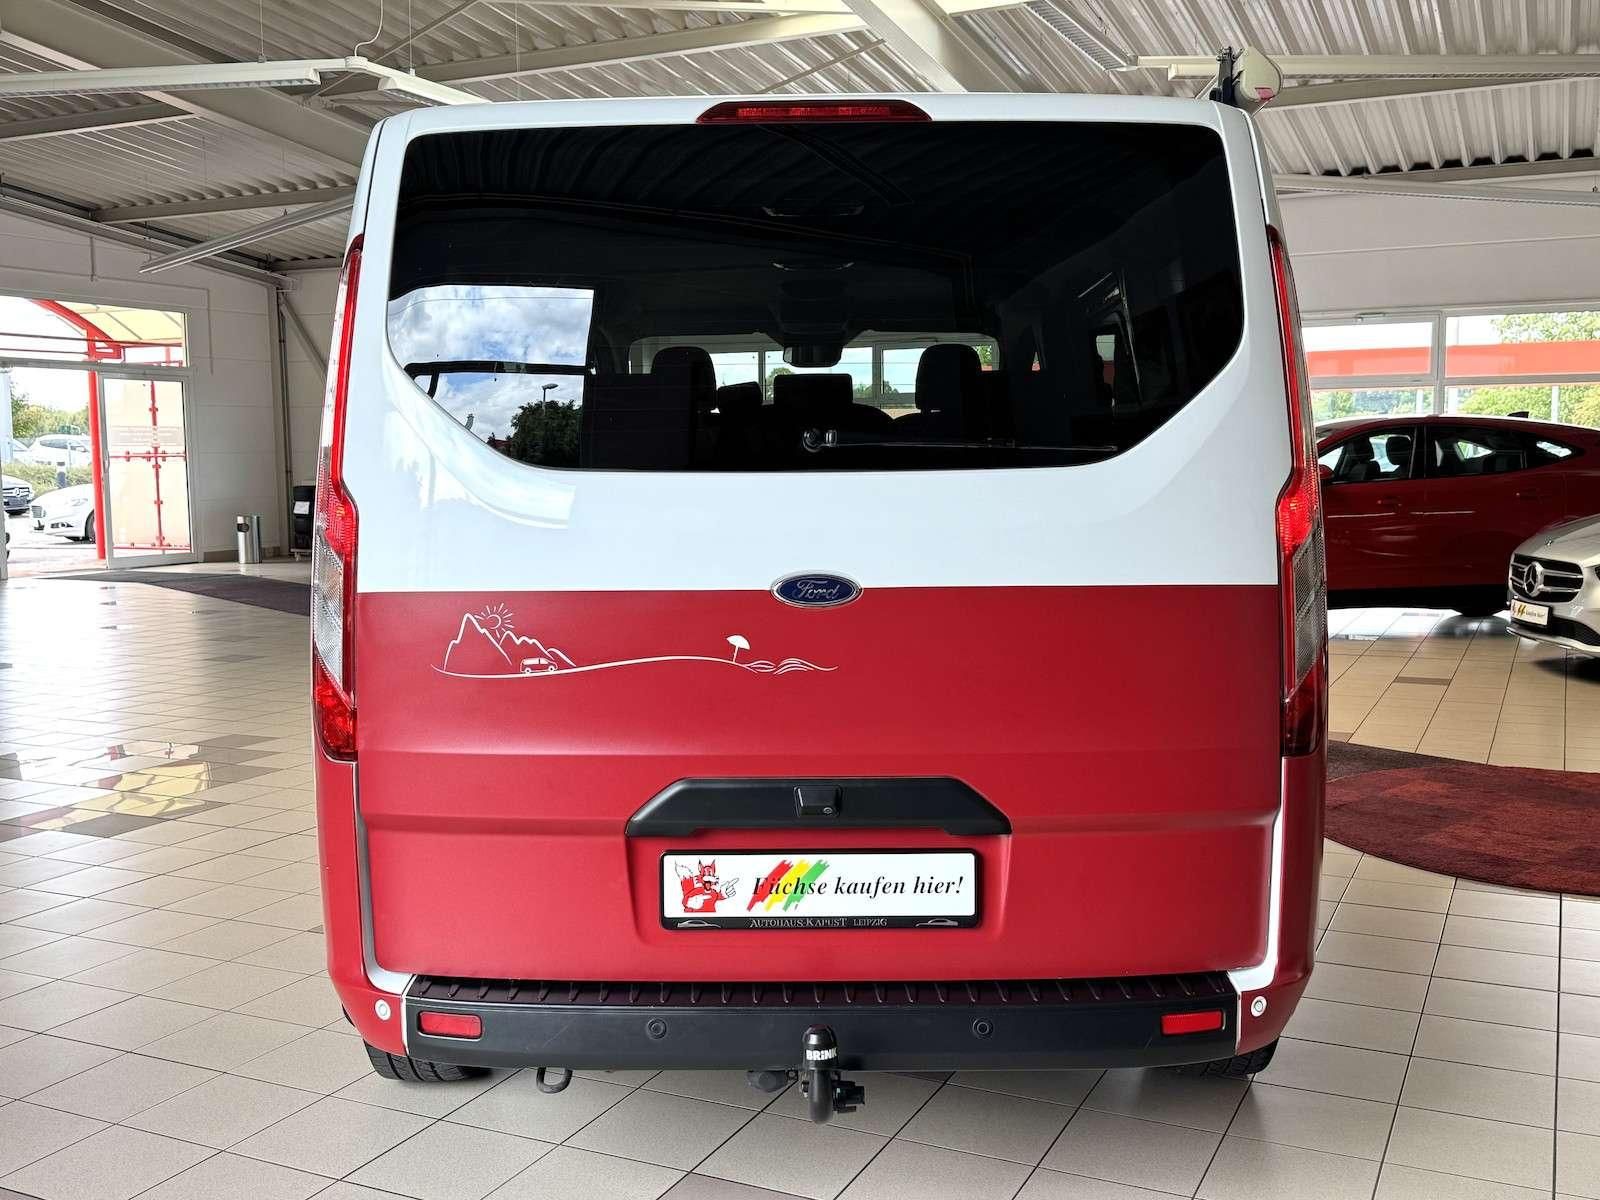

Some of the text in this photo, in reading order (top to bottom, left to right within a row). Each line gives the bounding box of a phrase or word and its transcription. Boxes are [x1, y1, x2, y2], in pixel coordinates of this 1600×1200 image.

[795, 579, 840, 600] Ford
[752, 876, 964, 899] Füchse kaufen hier!
[853, 918, 889, 927] LEIPZIG
